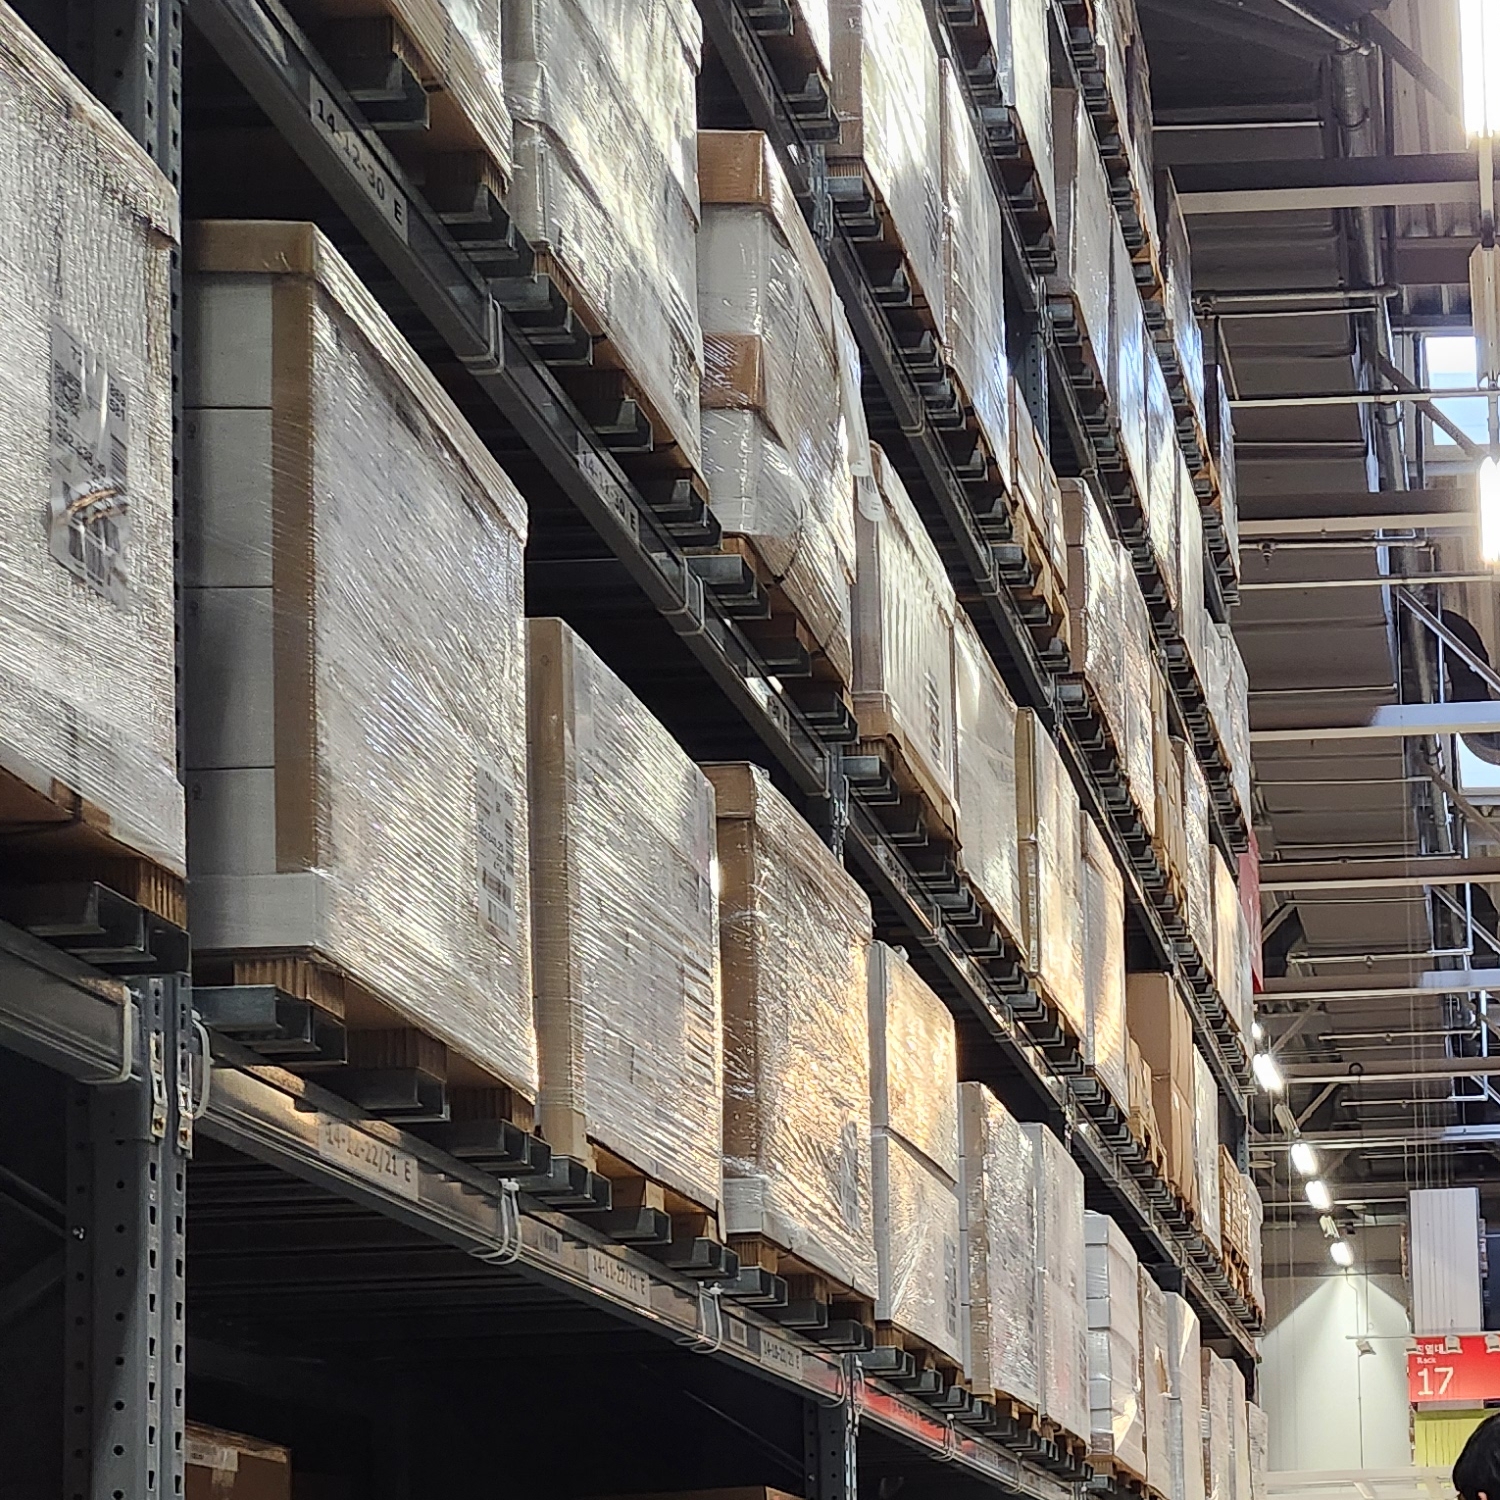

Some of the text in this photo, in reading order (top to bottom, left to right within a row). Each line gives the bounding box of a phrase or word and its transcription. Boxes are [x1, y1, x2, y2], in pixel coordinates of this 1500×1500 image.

[317, 99, 403, 226] 14-12-30 E
[404, 1160, 412, 1183] E
[1417, 1366, 1455, 1396] 17
